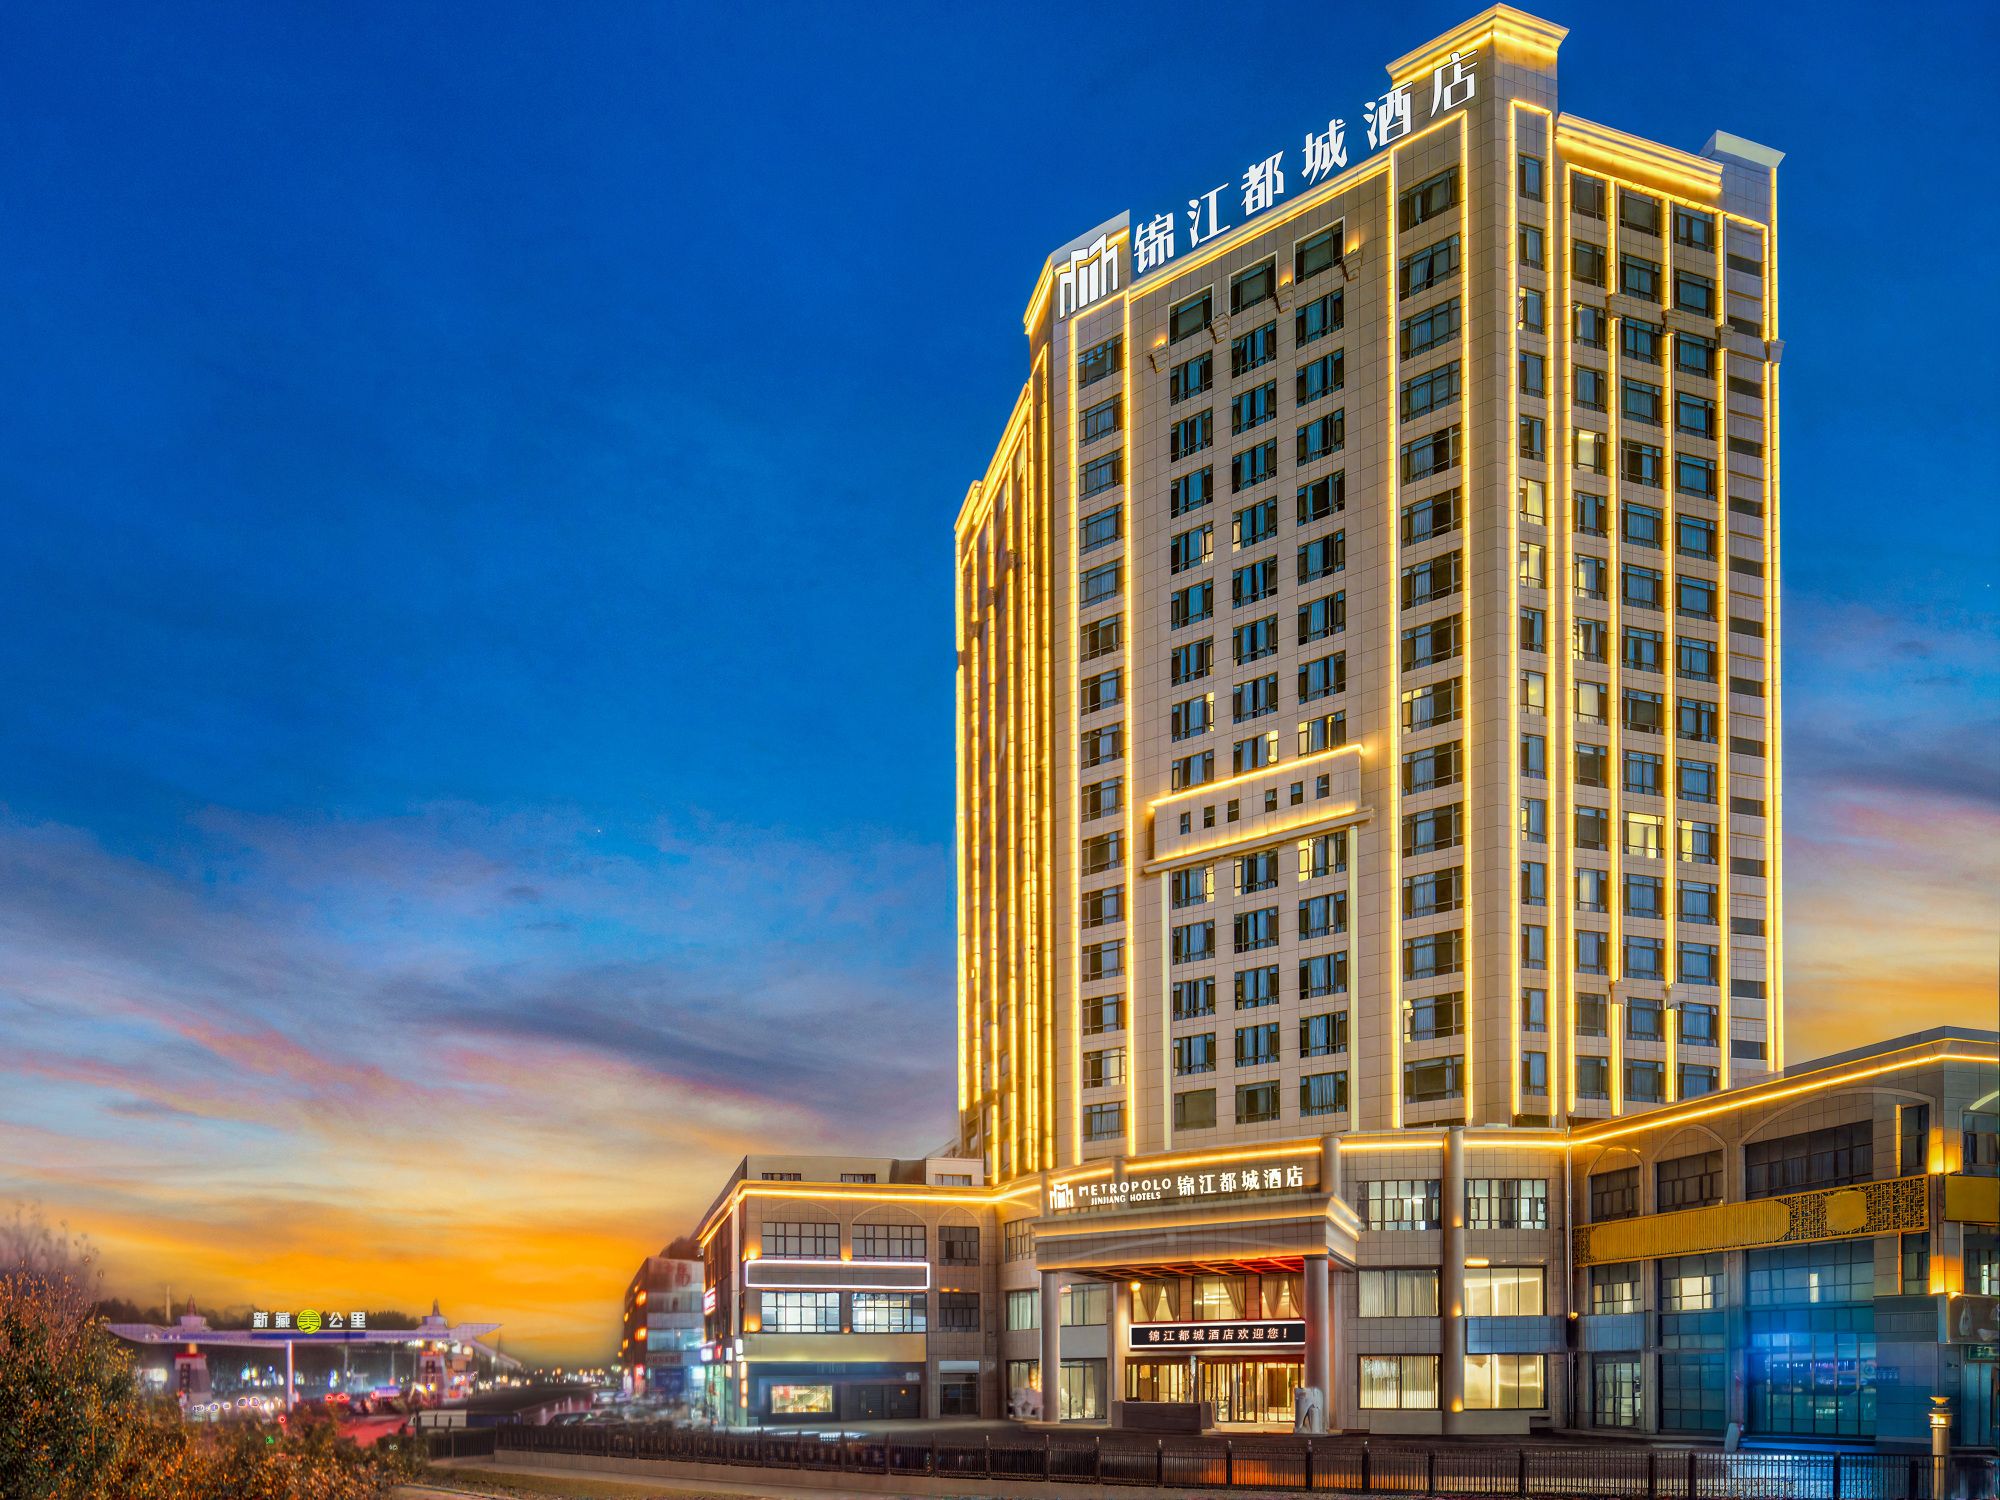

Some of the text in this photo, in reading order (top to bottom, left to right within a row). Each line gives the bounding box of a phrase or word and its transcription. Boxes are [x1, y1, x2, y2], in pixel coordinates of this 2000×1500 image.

[1133, 49, 1478, 274] 锦江都城酒店
[1078, 1178, 1172, 1198] METROPOLO
[1176, 1165, 1304, 1197] 锦江都城酒店
[1090, 1191, 1161, 1206] JINJIANG HOTELS
